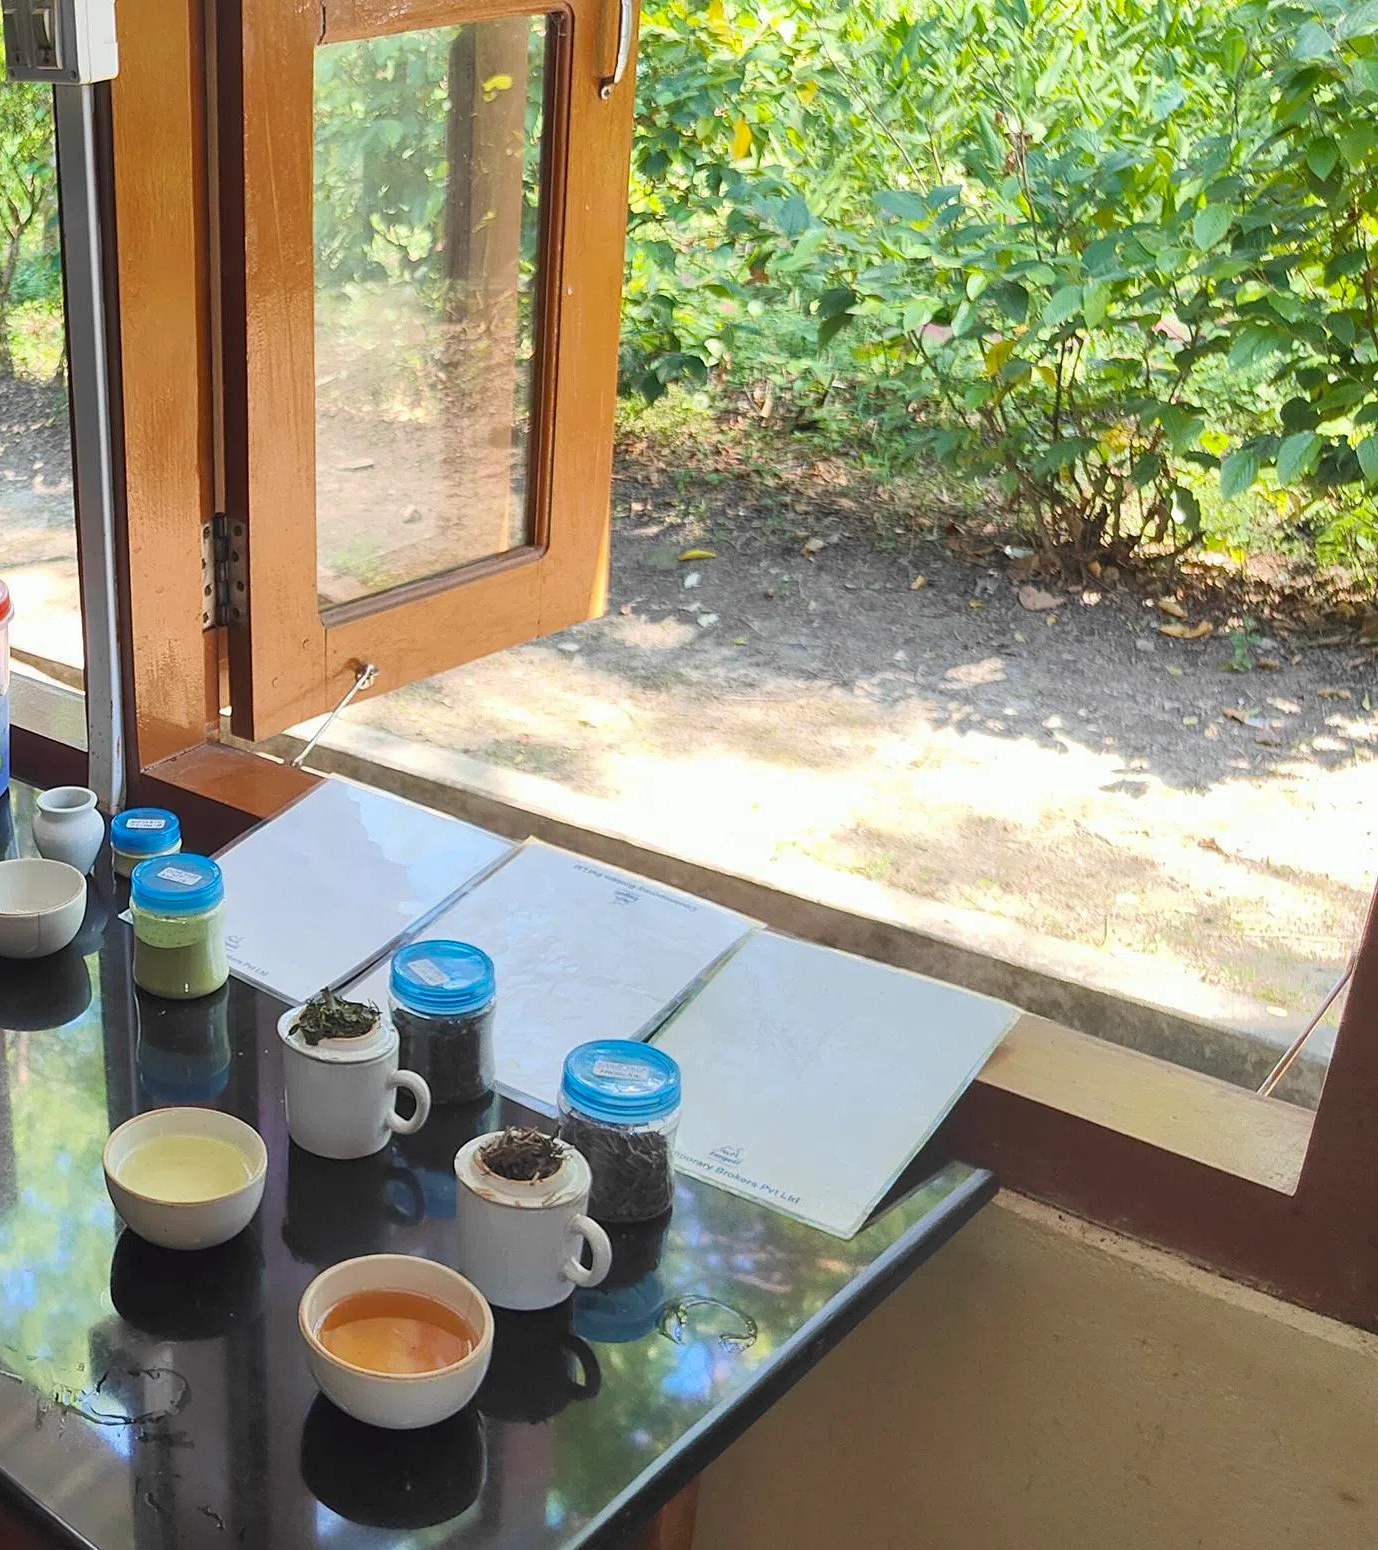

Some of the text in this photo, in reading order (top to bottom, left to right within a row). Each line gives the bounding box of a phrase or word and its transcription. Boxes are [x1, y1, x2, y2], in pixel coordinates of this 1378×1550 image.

[715, 1165, 758, 1188] Brokers
[759, 1183, 780, 1198] Pvt
[781, 1191, 801, 1205] Ltd
